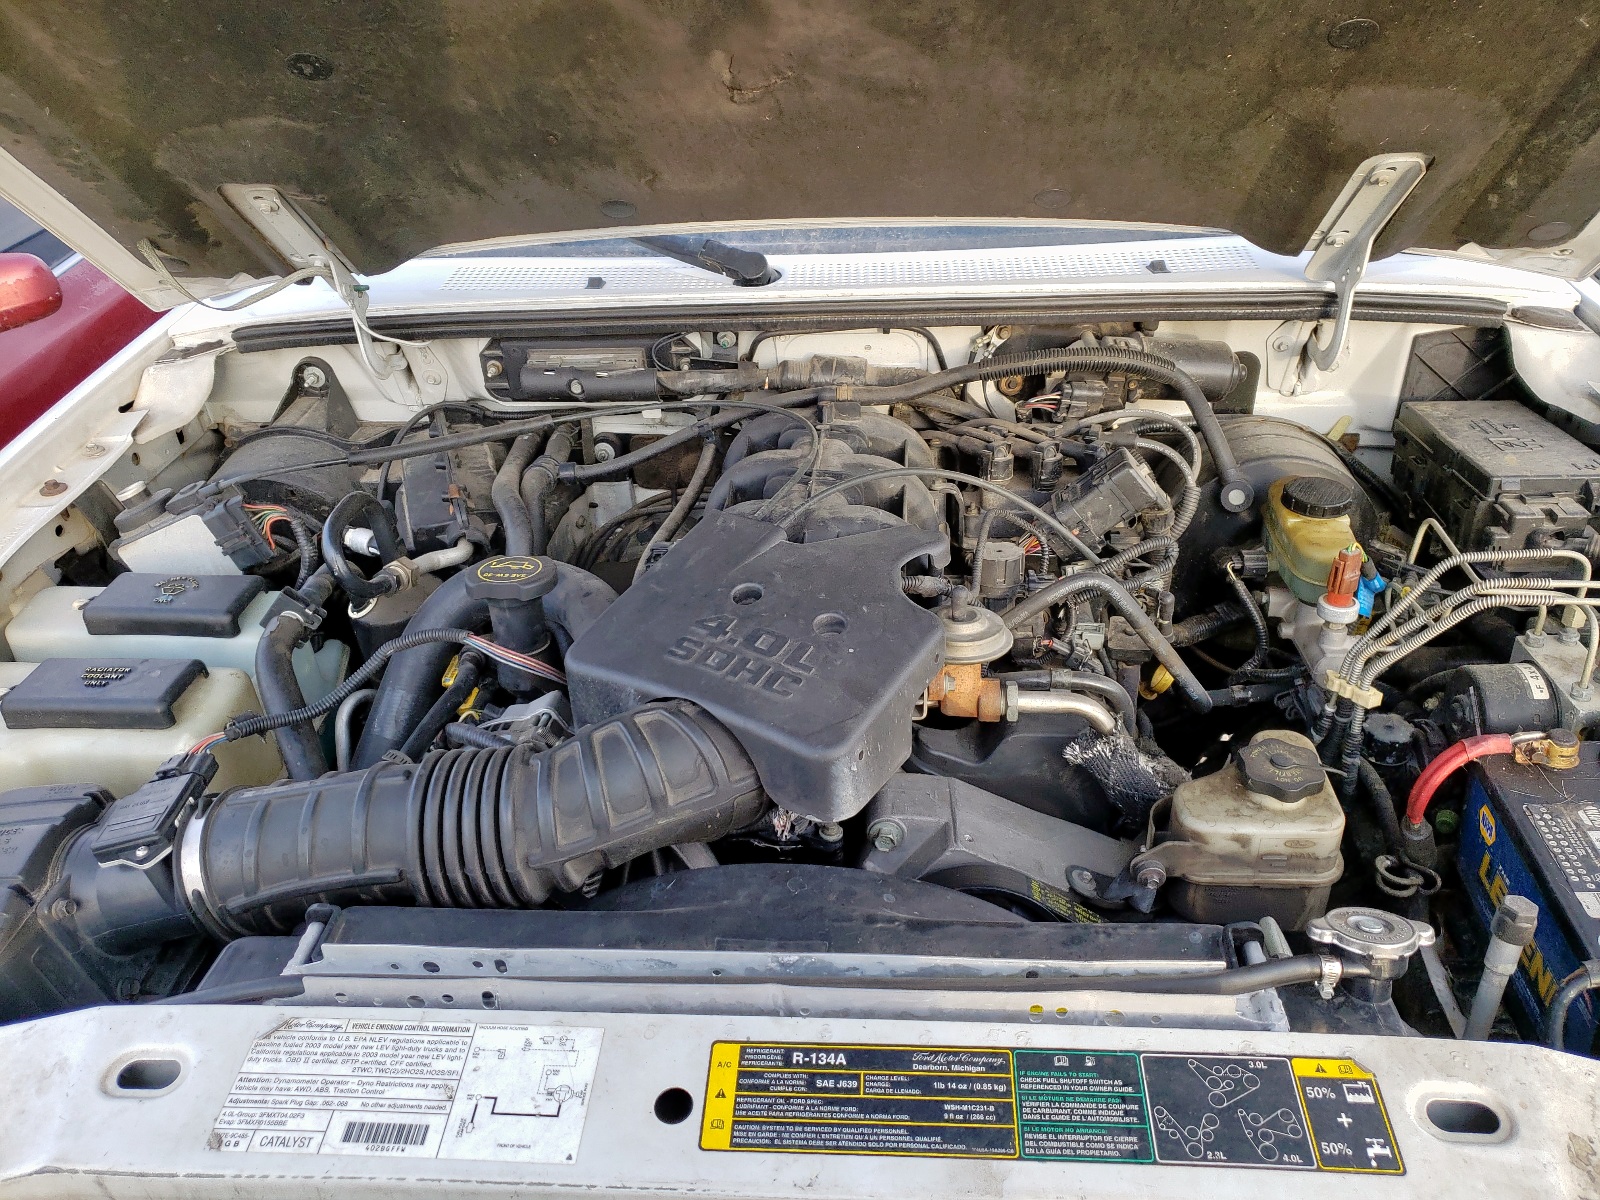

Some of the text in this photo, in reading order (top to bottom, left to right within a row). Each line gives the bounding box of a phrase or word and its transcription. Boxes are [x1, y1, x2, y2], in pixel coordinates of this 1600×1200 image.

[691, 614, 816, 675] 4.0L
[664, 636, 803, 699] SOHC
[792, 1052, 846, 1065] R-134A
[912, 1052, 1006, 1066] Ford Motor Company
[1249, 1061, 1268, 1069] 3.0L
[994, 1084, 1006, 1092] kg)
[1306, 1087, 1335, 1099] 50%
[260, 1136, 314, 1148] CATALYST
[1207, 1151, 1227, 1160] 2.3L
[1321, 1143, 1352, 1156] 50%
[1283, 1154, 1303, 1162] 4.0L
